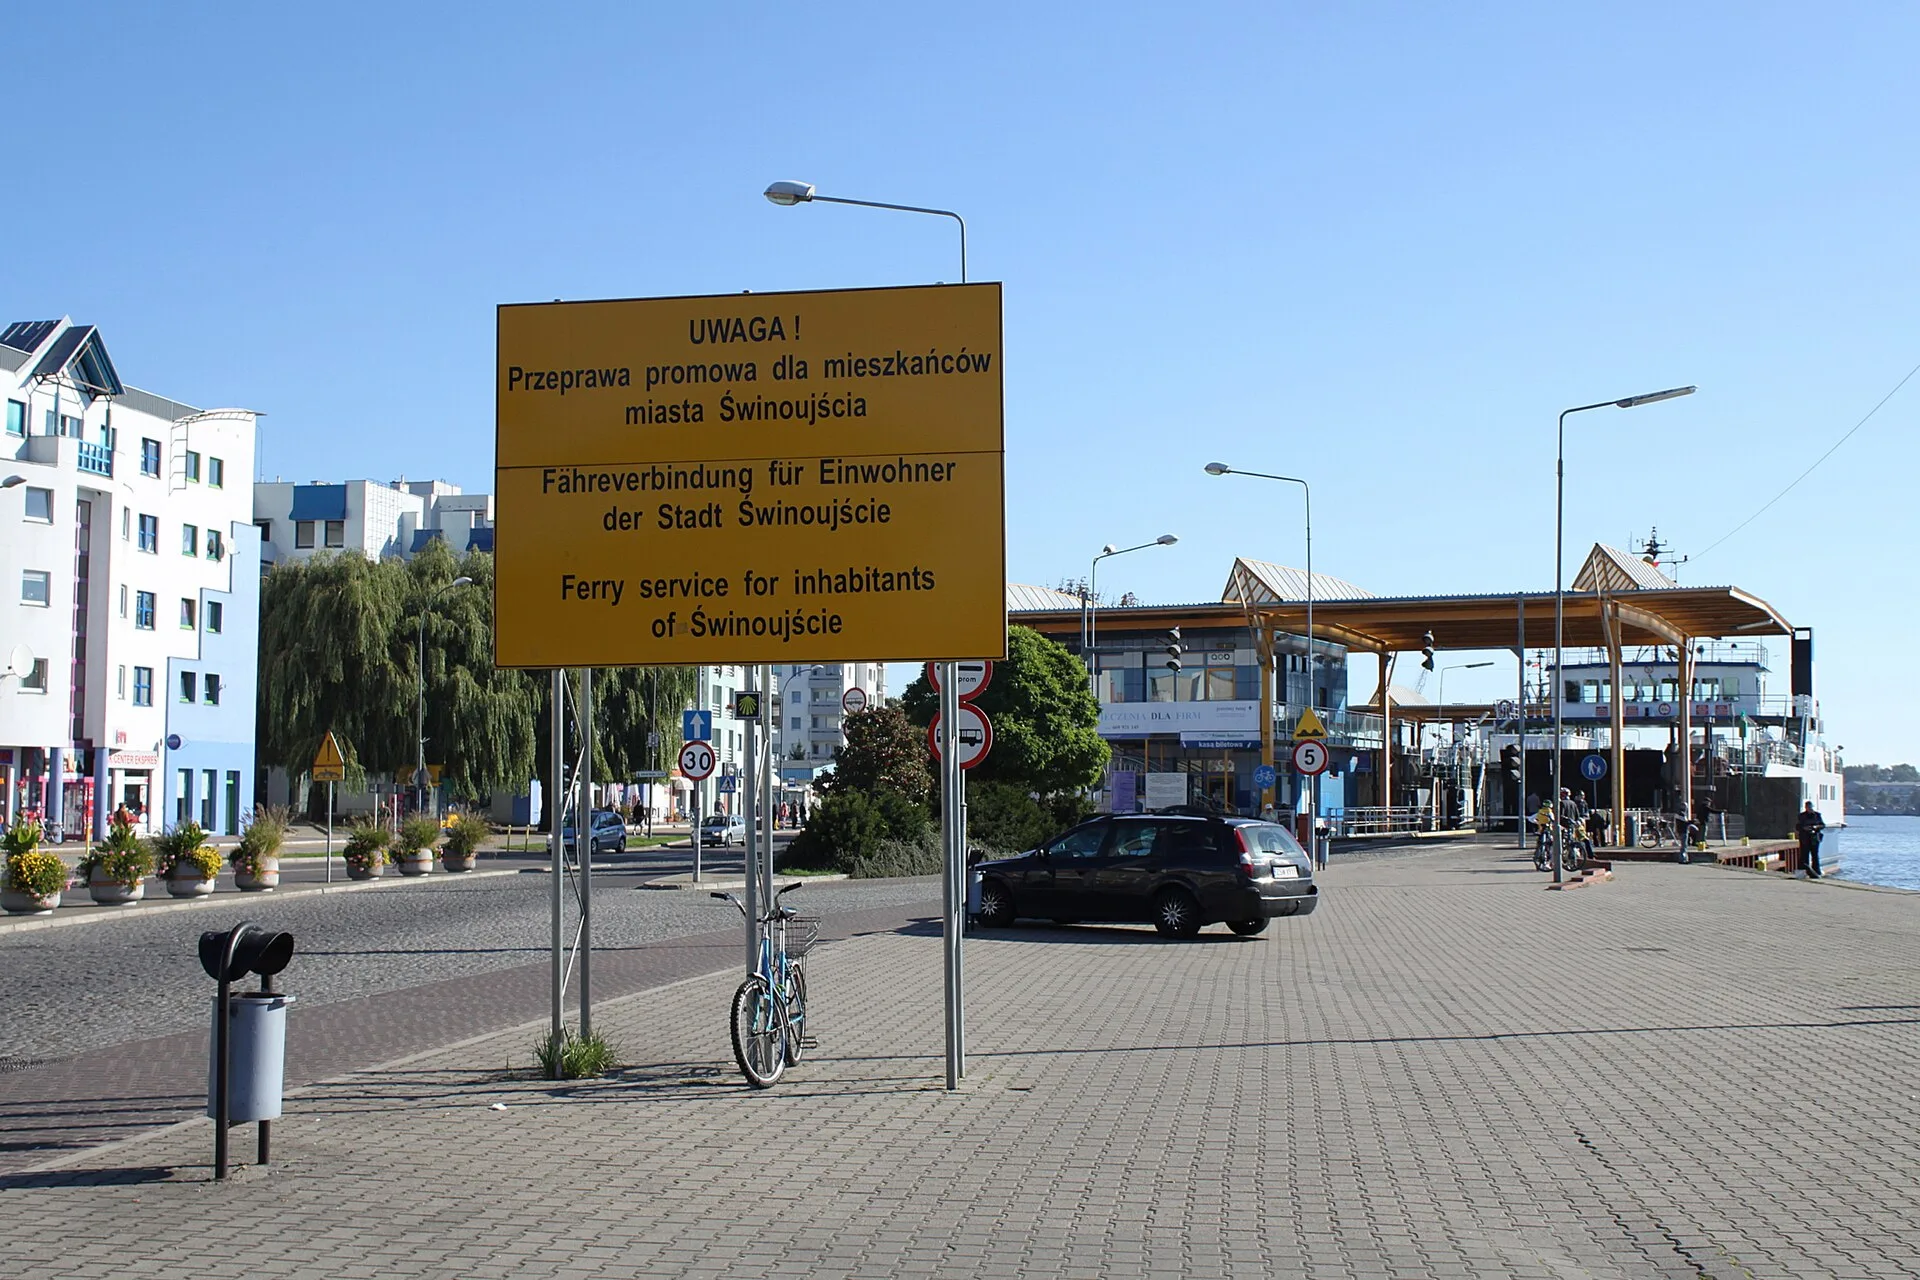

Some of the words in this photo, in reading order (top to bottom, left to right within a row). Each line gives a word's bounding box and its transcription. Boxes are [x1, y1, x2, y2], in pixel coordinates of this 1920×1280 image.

[690, 316, 786, 344] UWAGA
[509, 367, 630, 395] Przeprawa
[646, 363, 757, 394] promowa
[773, 355, 808, 380] dla
[825, 347, 991, 378] mieszkańców
[625, 397, 704, 425] miasta
[719, 389, 867, 425] Świnoujścia
[543, 467, 754, 493] Fähreverbindung
[769, 460, 805, 486] für
[818, 457, 957, 484] Einwohner
[602, 504, 644, 531] der
[657, 502, 723, 530] Stadt
[738, 495, 891, 531] Świnoujście
[561, 575, 624, 607] Ferry
[640, 572, 729, 599] service
[743, 569, 779, 597] for
[794, 566, 935, 595] inhabitants
[651, 611, 676, 638] of
[691, 604, 843, 642] Świnoujście
[1151, 712, 1171, 720] DLA
[1176, 711, 1201, 720] FIRM
[684, 750, 711, 771] 30
[1304, 749, 1315, 765] 5
